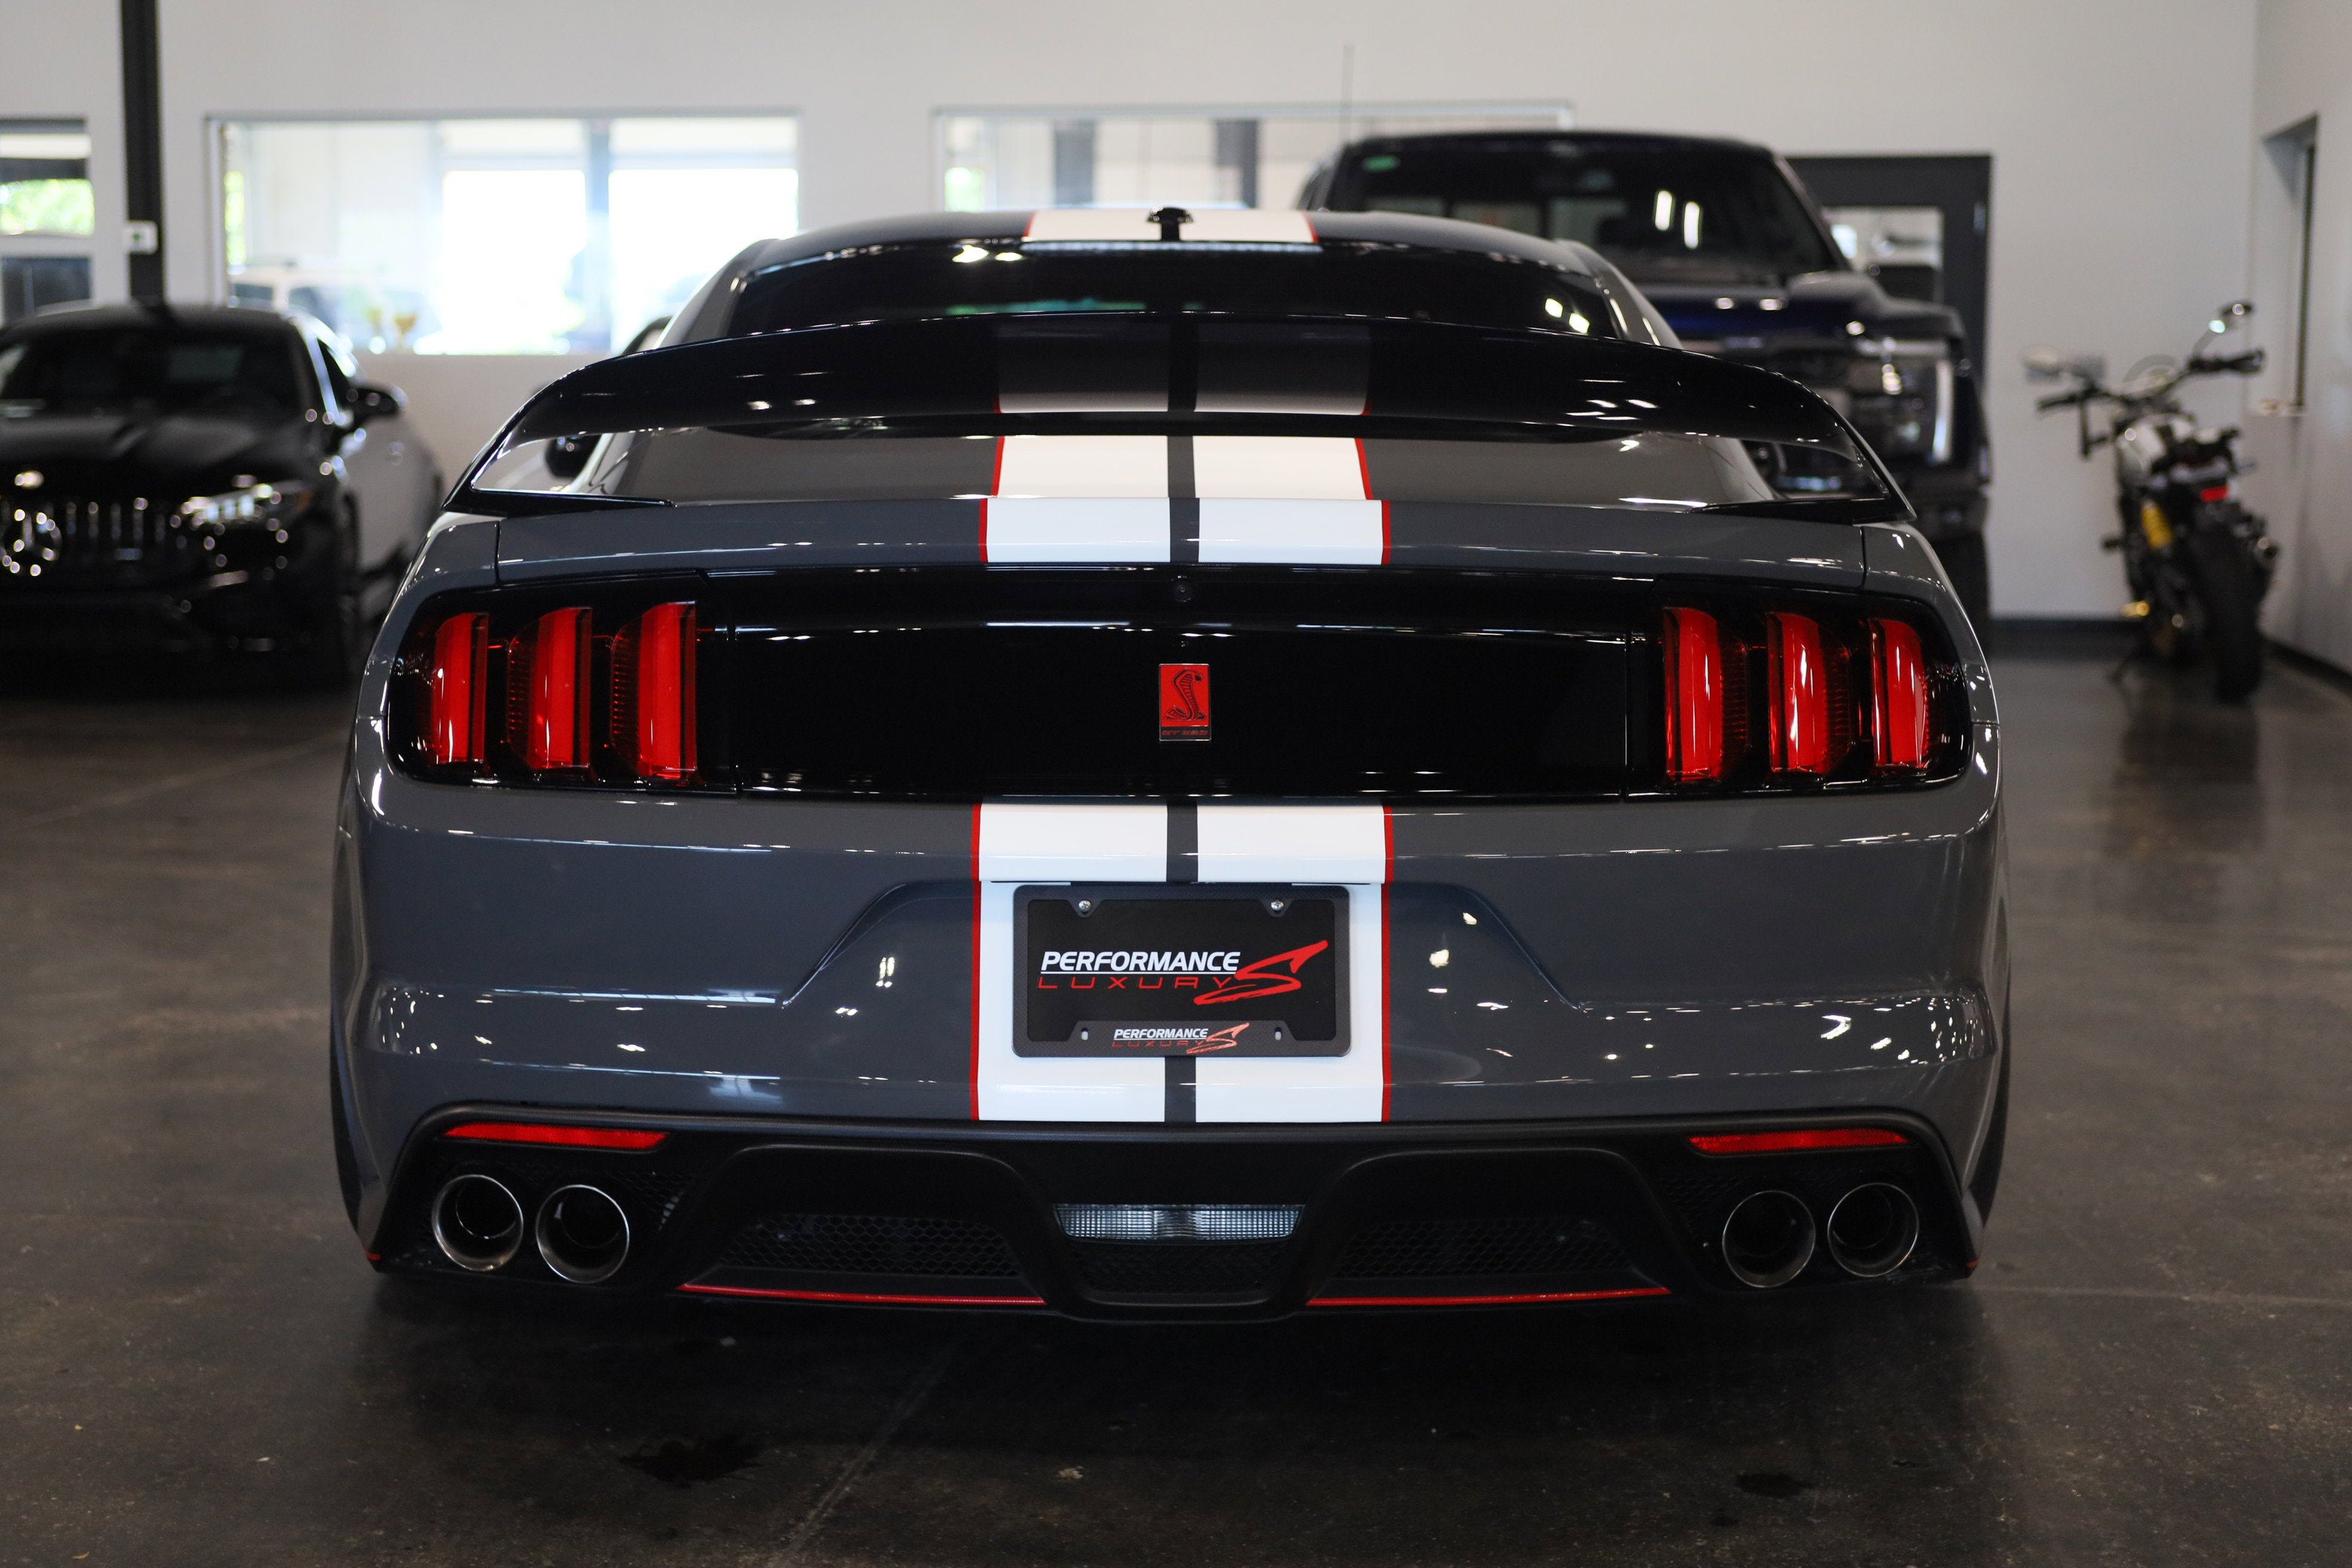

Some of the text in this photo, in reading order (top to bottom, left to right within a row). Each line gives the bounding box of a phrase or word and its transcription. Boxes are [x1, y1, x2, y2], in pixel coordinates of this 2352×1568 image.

[1041, 951, 1241, 972] PERFORMANCE
[1038, 976, 1234, 989] LUXURY
[1114, 1028, 1209, 1039] PERFORMANCE
